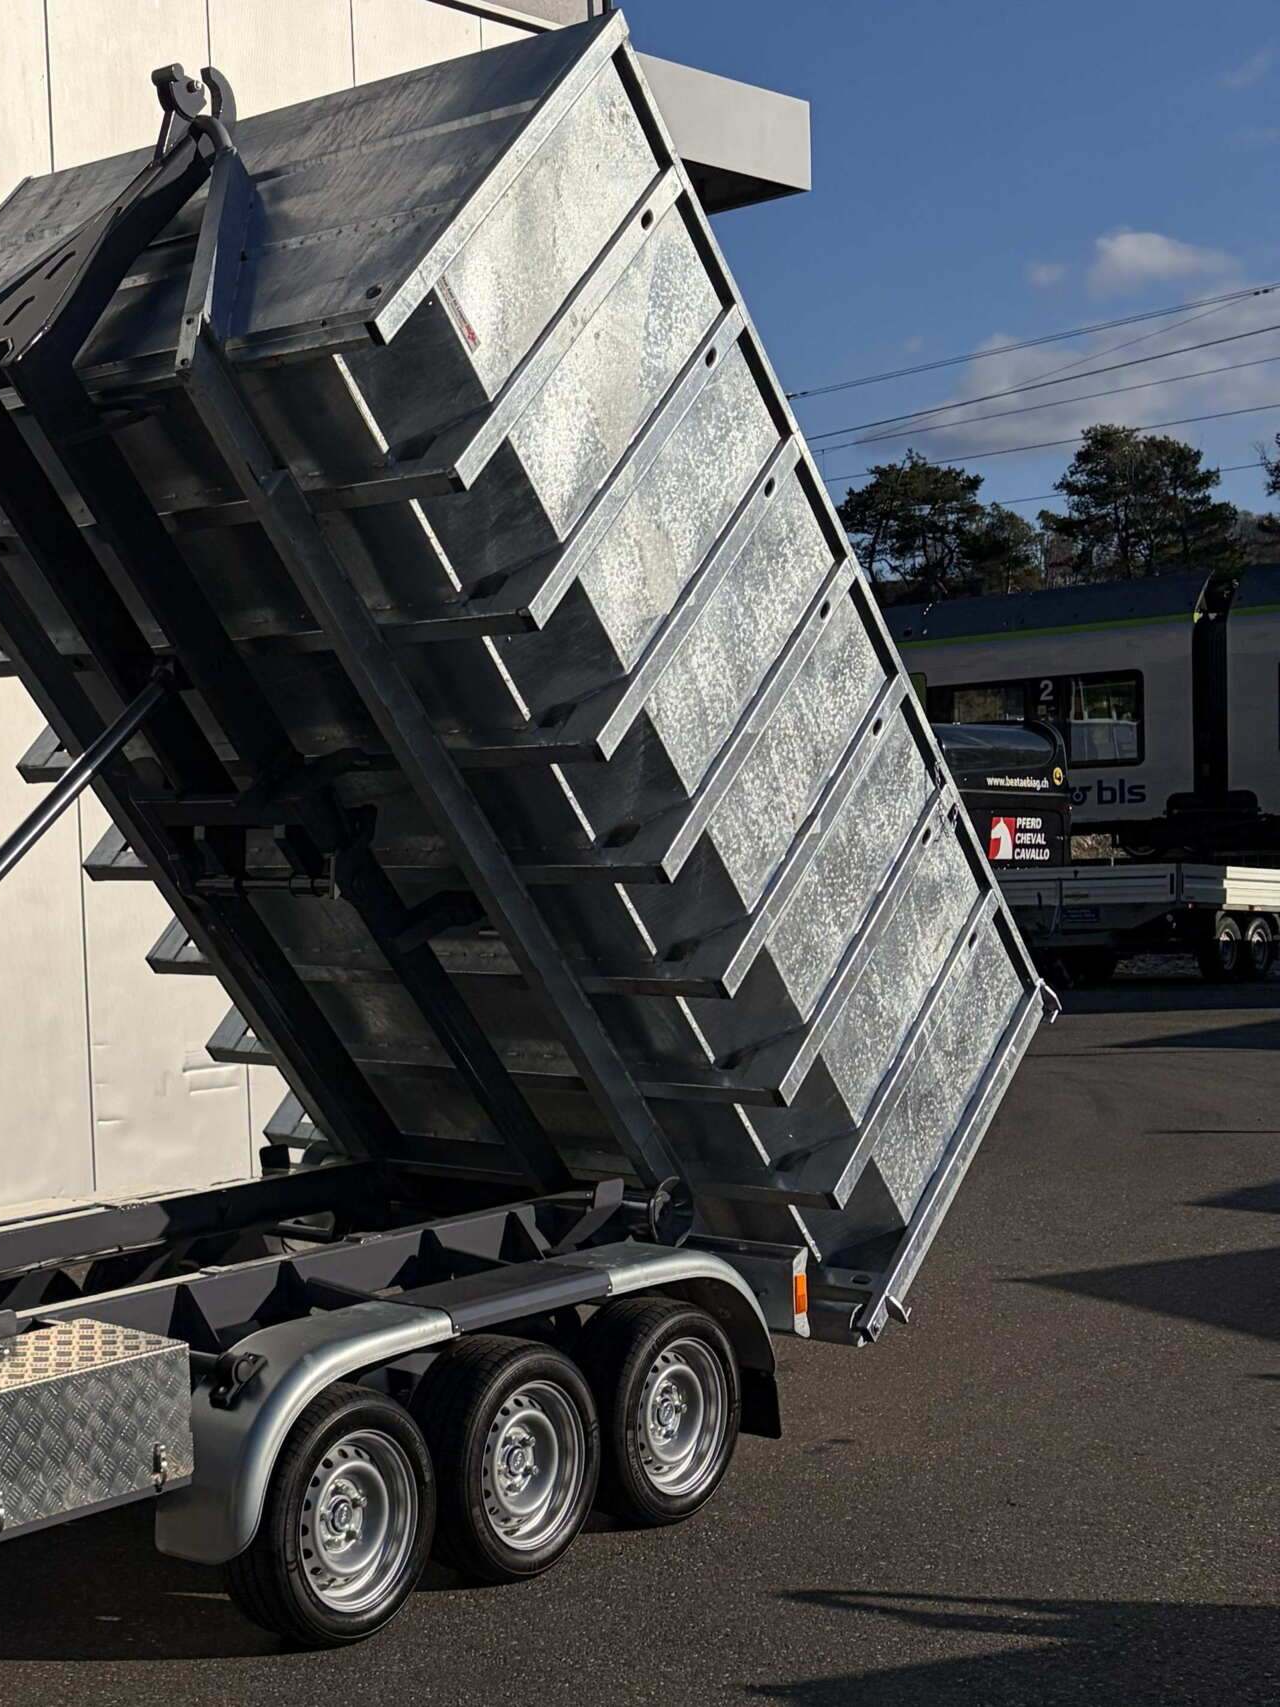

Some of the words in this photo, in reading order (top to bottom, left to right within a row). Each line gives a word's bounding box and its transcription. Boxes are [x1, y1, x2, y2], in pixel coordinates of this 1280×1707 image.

[1040, 680, 1054, 701] 2
[1097, 779, 1147, 806] bls
[1016, 816, 1042, 830] PFERD
[1015, 832, 1046, 845] CHEVAL
[1014, 848, 1050, 861] CAVALLO
